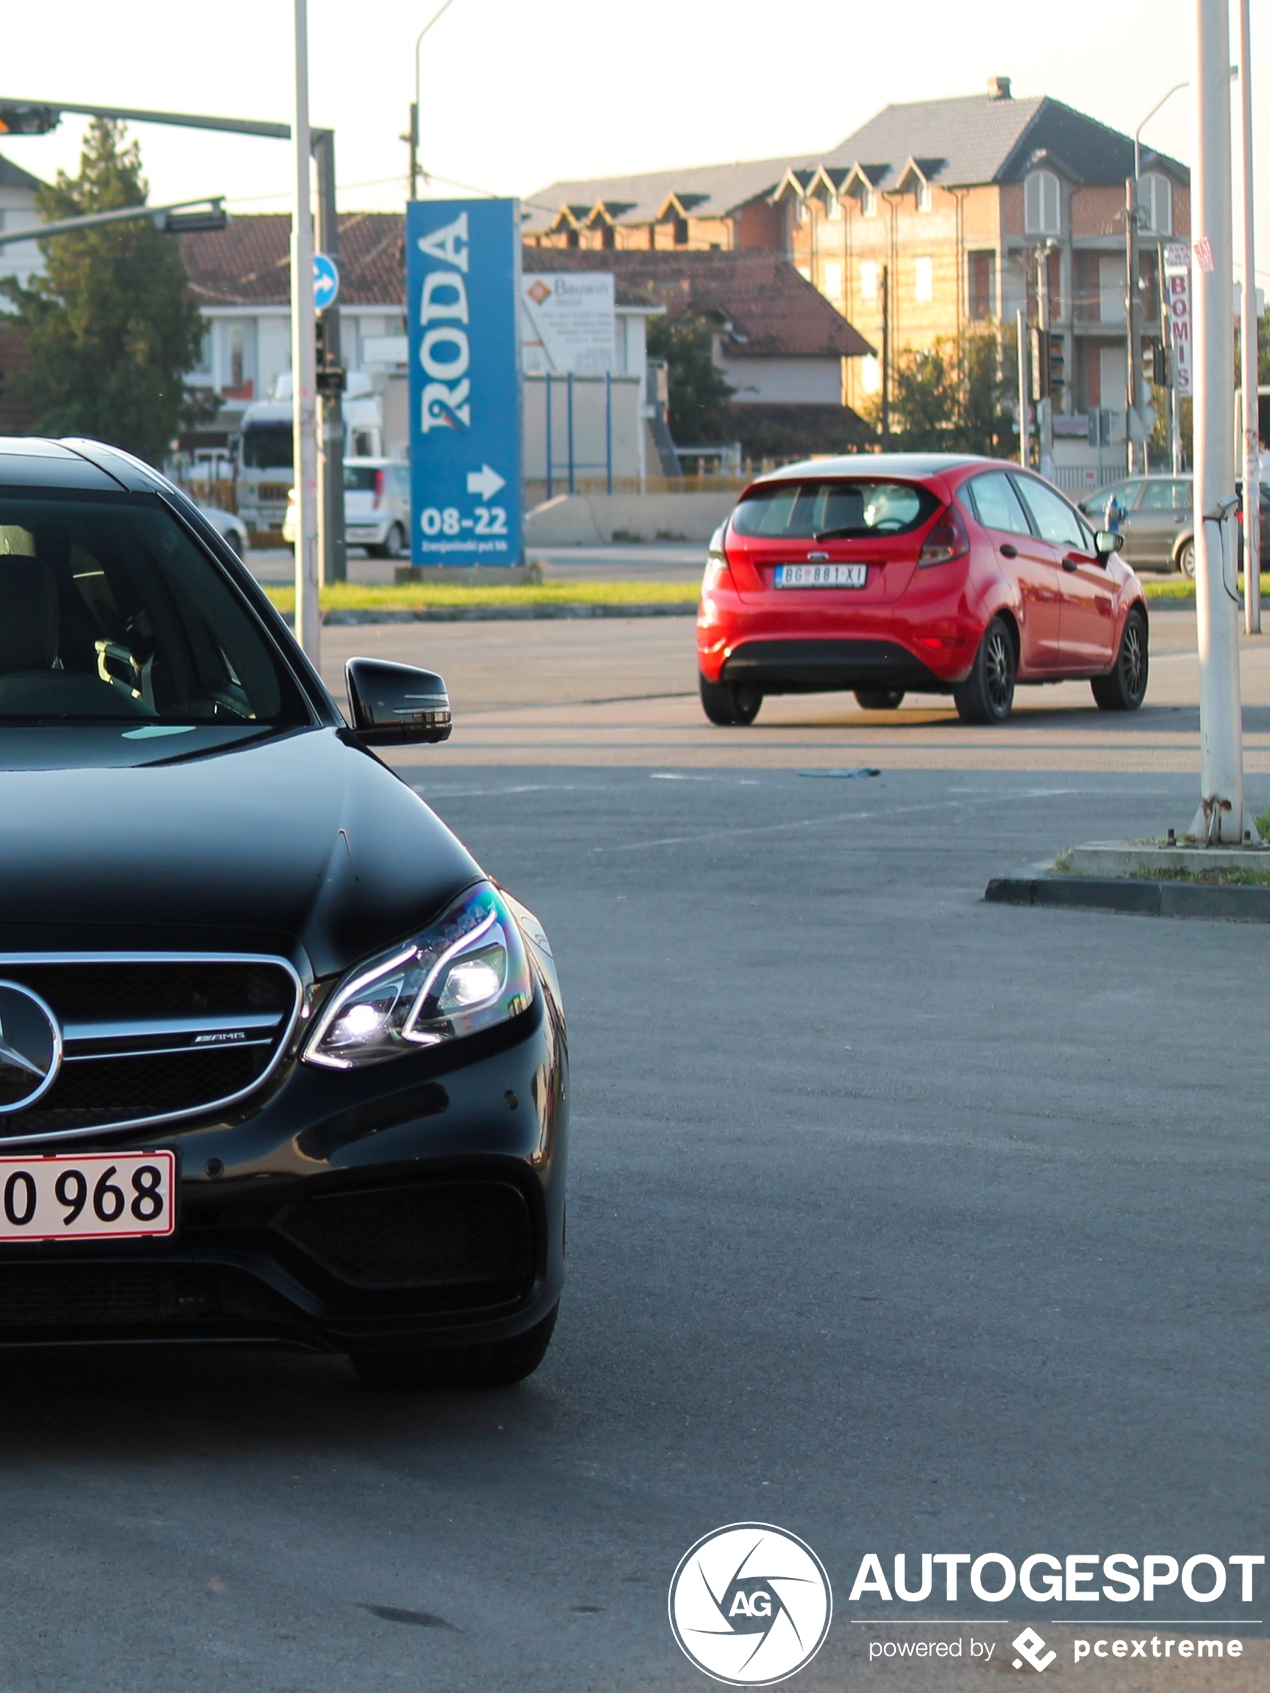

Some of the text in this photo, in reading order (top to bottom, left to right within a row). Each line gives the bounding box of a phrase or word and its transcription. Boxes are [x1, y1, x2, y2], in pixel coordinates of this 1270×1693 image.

[418, 211, 471, 434] RODA
[1171, 276, 1190, 388] BOMIS
[420, 507, 508, 536] 08-22
[785, 567, 802, 582] BG
[55, 1165, 164, 1226] 968
